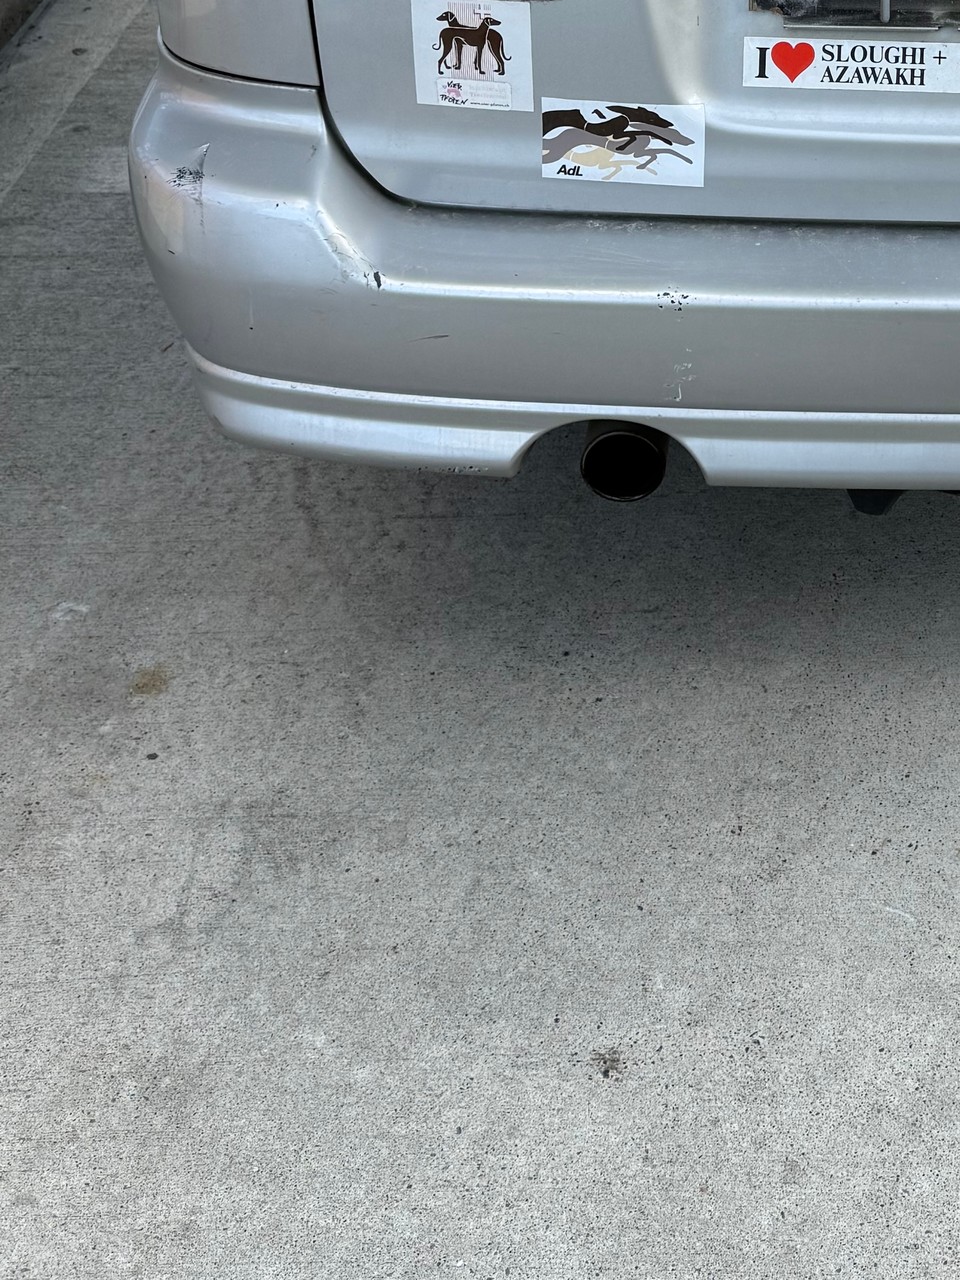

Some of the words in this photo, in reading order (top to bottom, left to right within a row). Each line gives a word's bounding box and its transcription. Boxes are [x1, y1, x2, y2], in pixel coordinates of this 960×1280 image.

[754, 46, 770, 79] I
[820, 43, 926, 66] SLOUGHI
[820, 66, 926, 87] AZAWAKH
[556, 164, 584, 177] AdL
